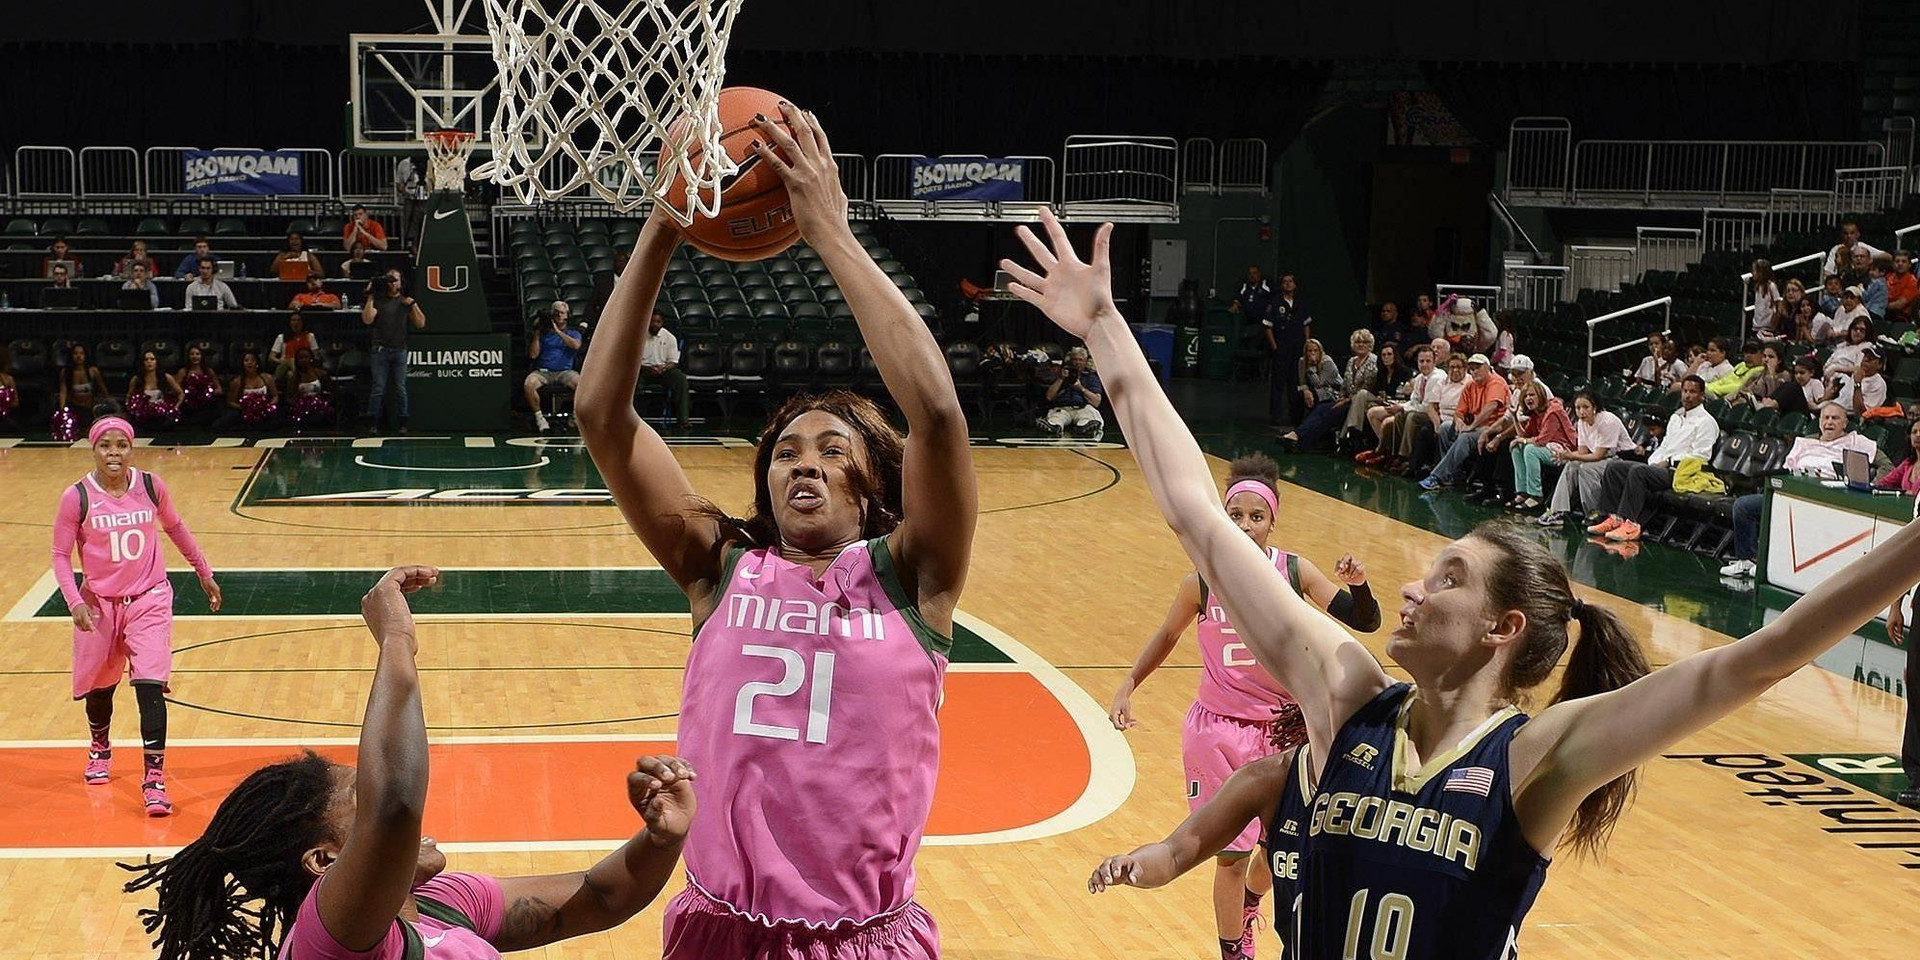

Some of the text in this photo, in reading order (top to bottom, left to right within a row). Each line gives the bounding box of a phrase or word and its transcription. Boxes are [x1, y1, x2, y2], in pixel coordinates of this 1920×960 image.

[913, 181, 972, 196] SPORTS RADIO
[729, 203, 796, 238] ELIT
[427, 266, 469, 292] U
[437, 369, 463, 378] BUICK
[468, 368, 503, 377] GMC
[110, 529, 145, 563] 10
[733, 644, 835, 744] 21
[1310, 792, 1482, 871] GEORGIA
